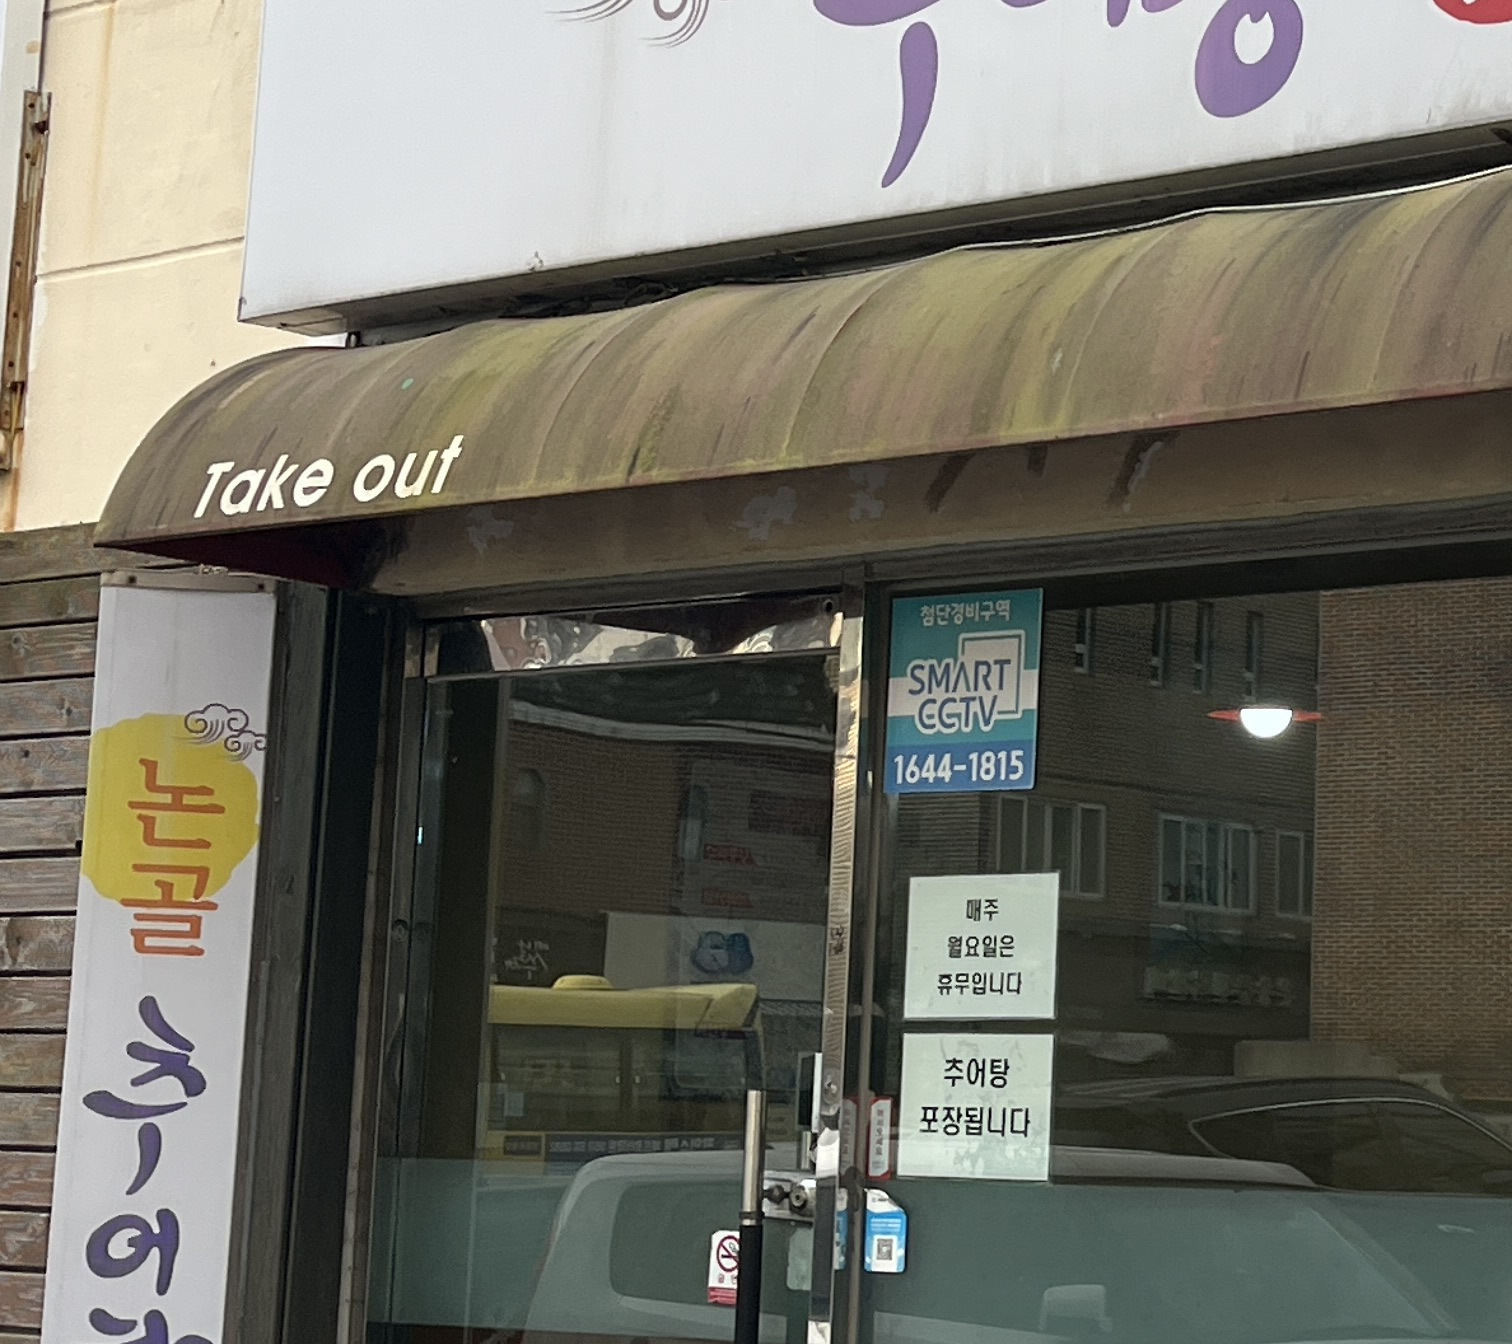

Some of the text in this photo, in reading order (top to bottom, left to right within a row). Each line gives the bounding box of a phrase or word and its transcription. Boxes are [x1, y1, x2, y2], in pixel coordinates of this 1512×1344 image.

[193, 434, 465, 519] Take out
[920, 599, 1011, 627] 첨단경비구역
[907, 658, 1012, 696] SMART
[917, 694, 998, 730] CCTV
[893, 749, 1025, 785] 1644-1815
[119, 757, 226, 957] 논골
[966, 898, 1000, 922] 매주
[947, 934, 1016, 959] 월요일은
[937, 971, 1022, 996] 휴무입니다
[943, 1057, 1011, 1090] 추어탕
[919, 1105, 1031, 1138] 포장됩니다
